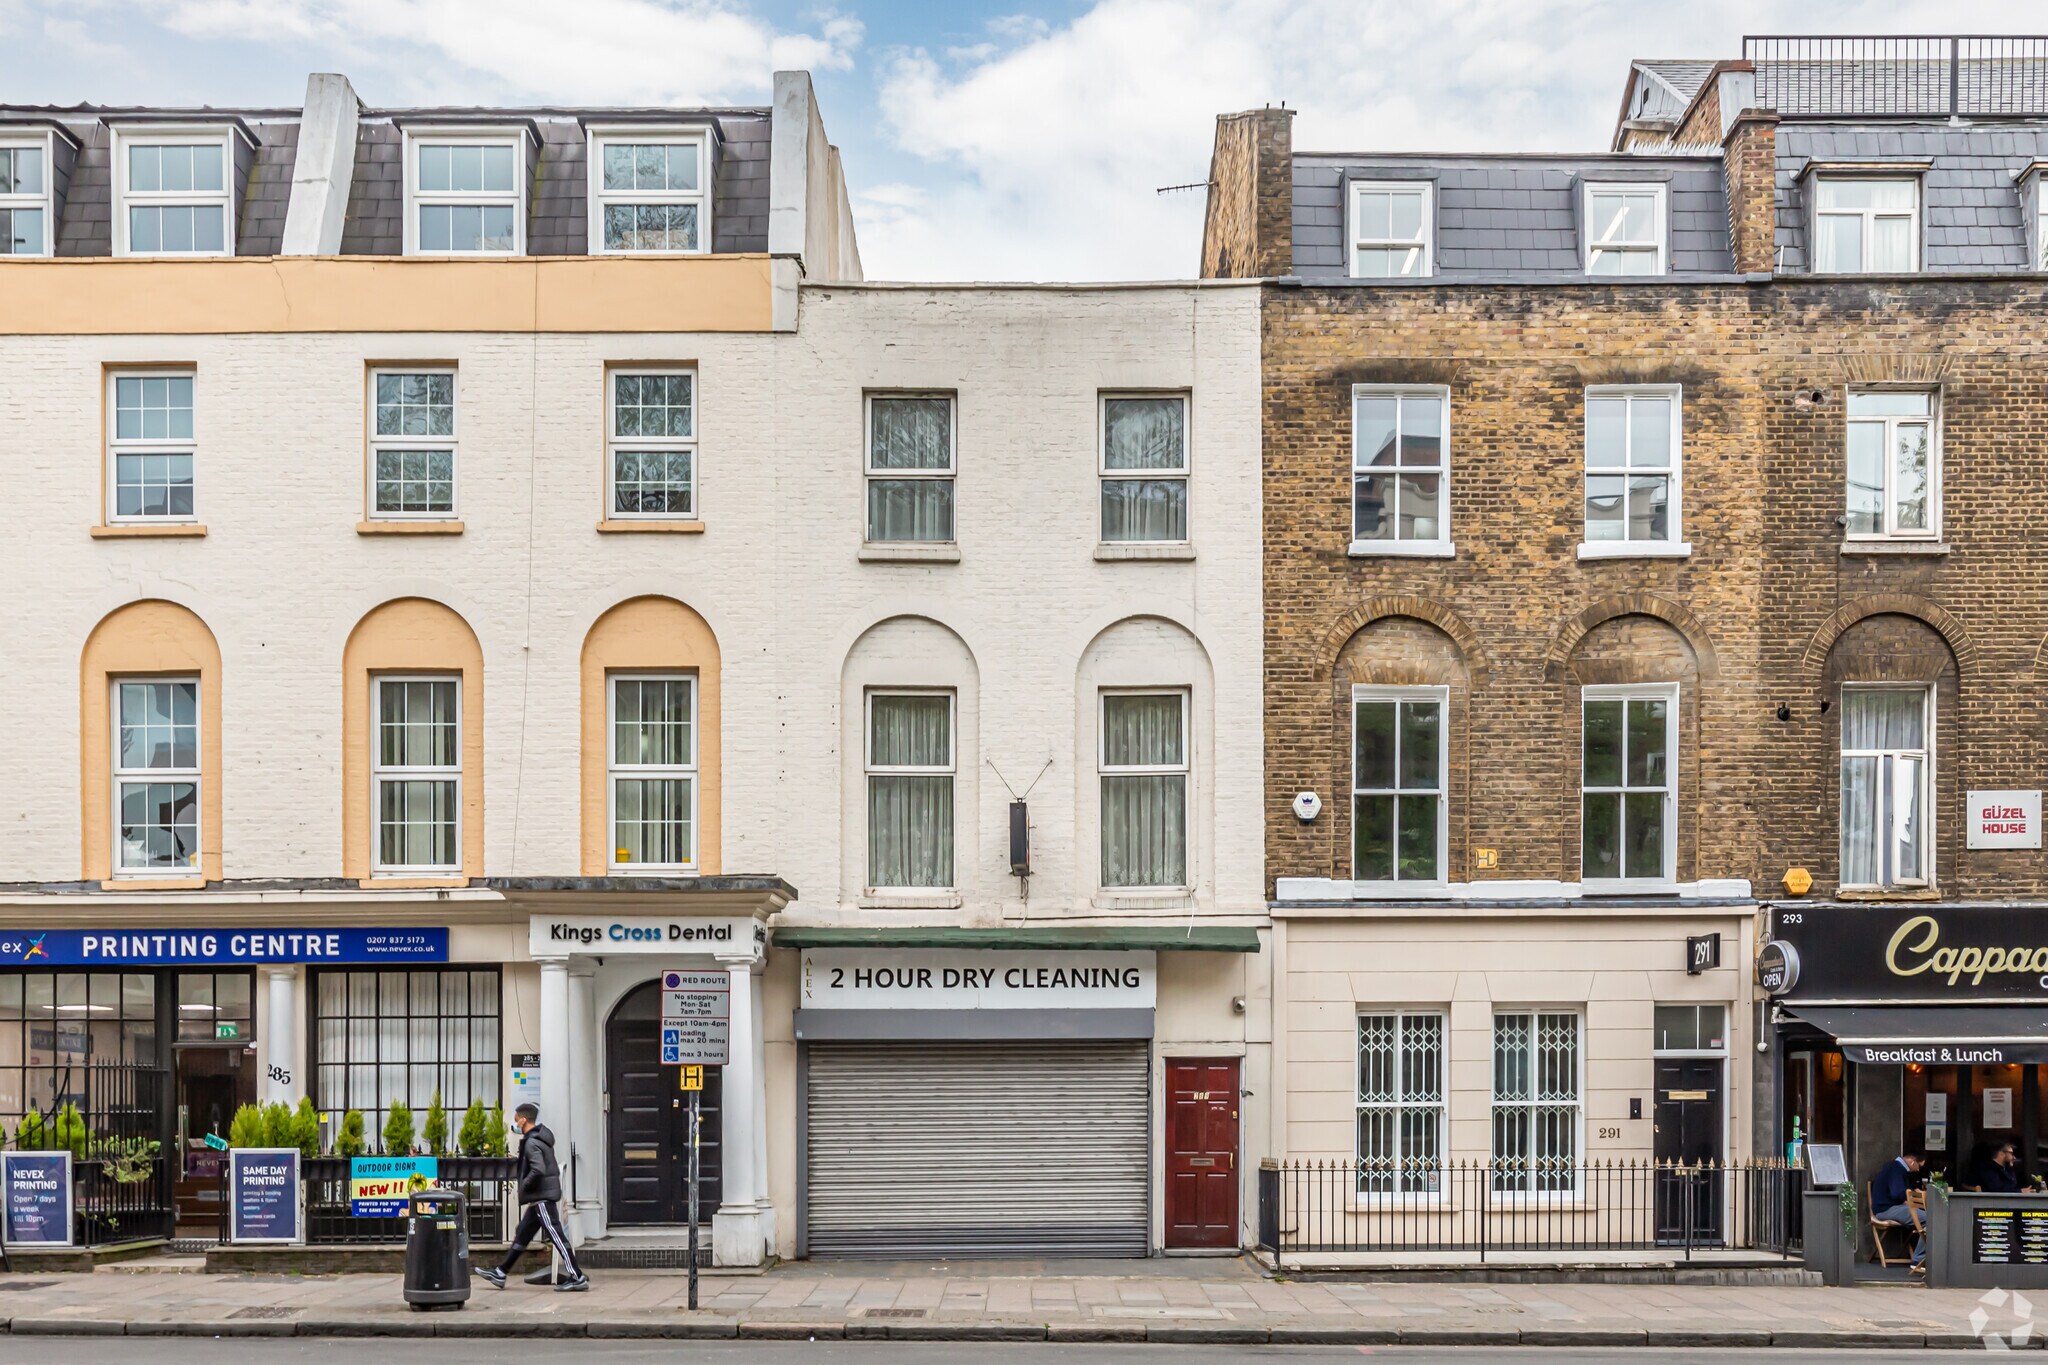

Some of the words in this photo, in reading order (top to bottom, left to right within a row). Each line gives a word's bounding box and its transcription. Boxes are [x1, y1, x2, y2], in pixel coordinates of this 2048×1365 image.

[1982, 805, 2026, 819] GÜZEL
[1982, 823, 2026, 834] HOUSE
[1783, 914, 1802, 924] 293
[551, 924, 602, 943] Kings
[608, 924, 662, 941] Cross
[669, 924, 732, 941] Dental
[83, 935, 217, 957] PRINTING
[230, 934, 340, 956] CENTRE
[366, 936, 387, 944] 0207
[389, 936, 405, 944] 837
[406, 936, 425, 944] 5173
[366, 945, 435, 953] www.nevex.co.uk
[1694, 940, 1710, 965] 291
[805, 957, 813, 998] ALEX
[830, 968, 844, 988] 2
[855, 968, 933, 988] HOUR
[942, 968, 995, 988] DRY
[1004, 968, 1140, 988] CLEANING
[1763, 973, 1781, 986] OPEN
[1865, 1048, 1936, 1062] Breakfast
[1940, 1048, 1952, 1062] &
[1956, 1048, 2003, 1062] Lunch
[268, 1063, 291, 1084] 285
[684, 1067, 699, 1087] H
[1599, 1127, 1621, 1139] 291
[243, 1166, 268, 1175] SAME
[270, 1166, 287, 1175] DAY
[357, 1163, 392, 1173] OUTDOOR
[394, 1161, 416, 1171] SIGNS
[13, 1169, 44, 1179] NEVEX
[13, 1181, 57, 1190] PRINTING
[243, 1176, 285, 1185] PRINTING
[359, 1182, 390, 1197] NEW
[13, 1195, 33, 1203] Open
[39, 1195, 56, 1203] days
[25, 1215, 44, 1223] 10pm
